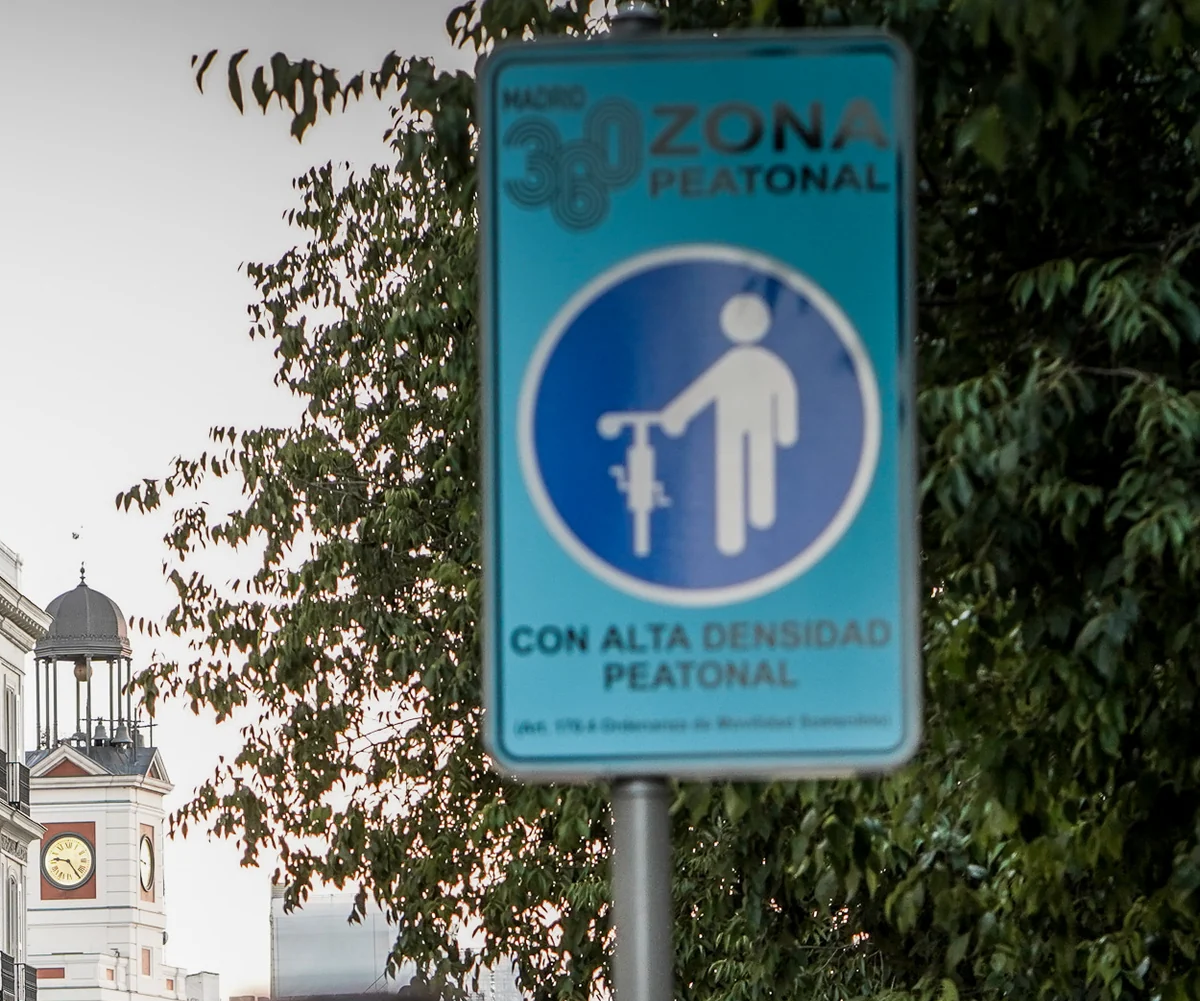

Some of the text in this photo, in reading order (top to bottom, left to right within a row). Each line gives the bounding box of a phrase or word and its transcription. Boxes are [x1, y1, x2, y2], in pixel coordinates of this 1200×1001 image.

[502, 84, 586, 110] MADRID
[650, 98, 889, 156] ZONA
[649, 163, 889, 198] PEATONAL
[510, 618, 892, 656] CON ALTA DENSIDAD
[603, 659, 797, 691] PEATONAL
